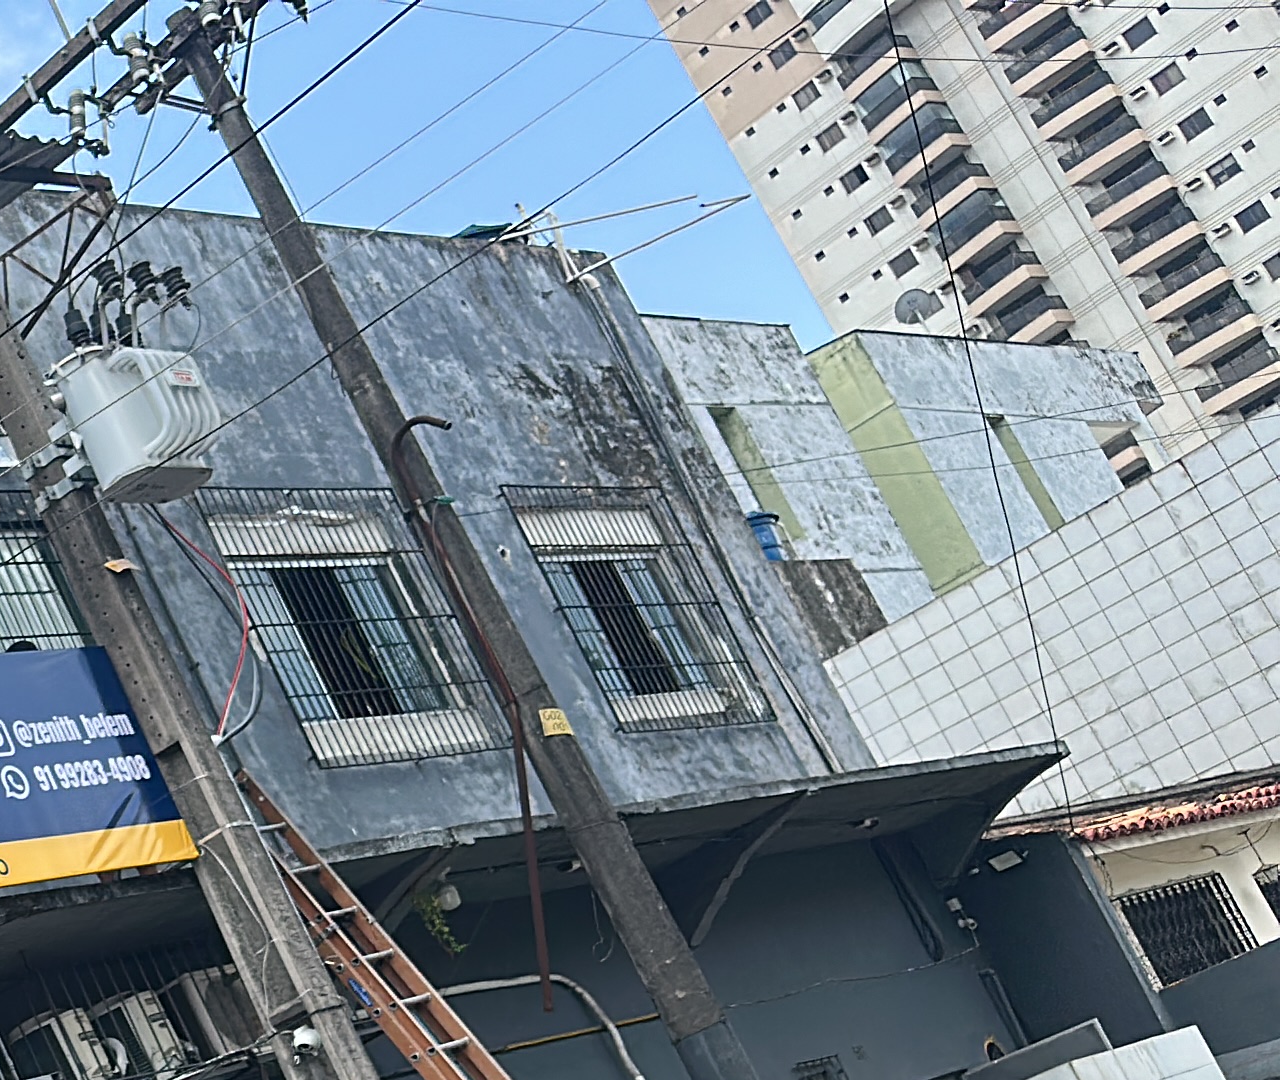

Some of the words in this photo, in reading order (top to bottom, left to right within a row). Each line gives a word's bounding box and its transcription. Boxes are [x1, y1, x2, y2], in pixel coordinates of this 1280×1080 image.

[12, 712, 135, 749] @zenith_belem
[33, 764, 59, 792] 91
[58, 754, 151, 790] 99283-4908
